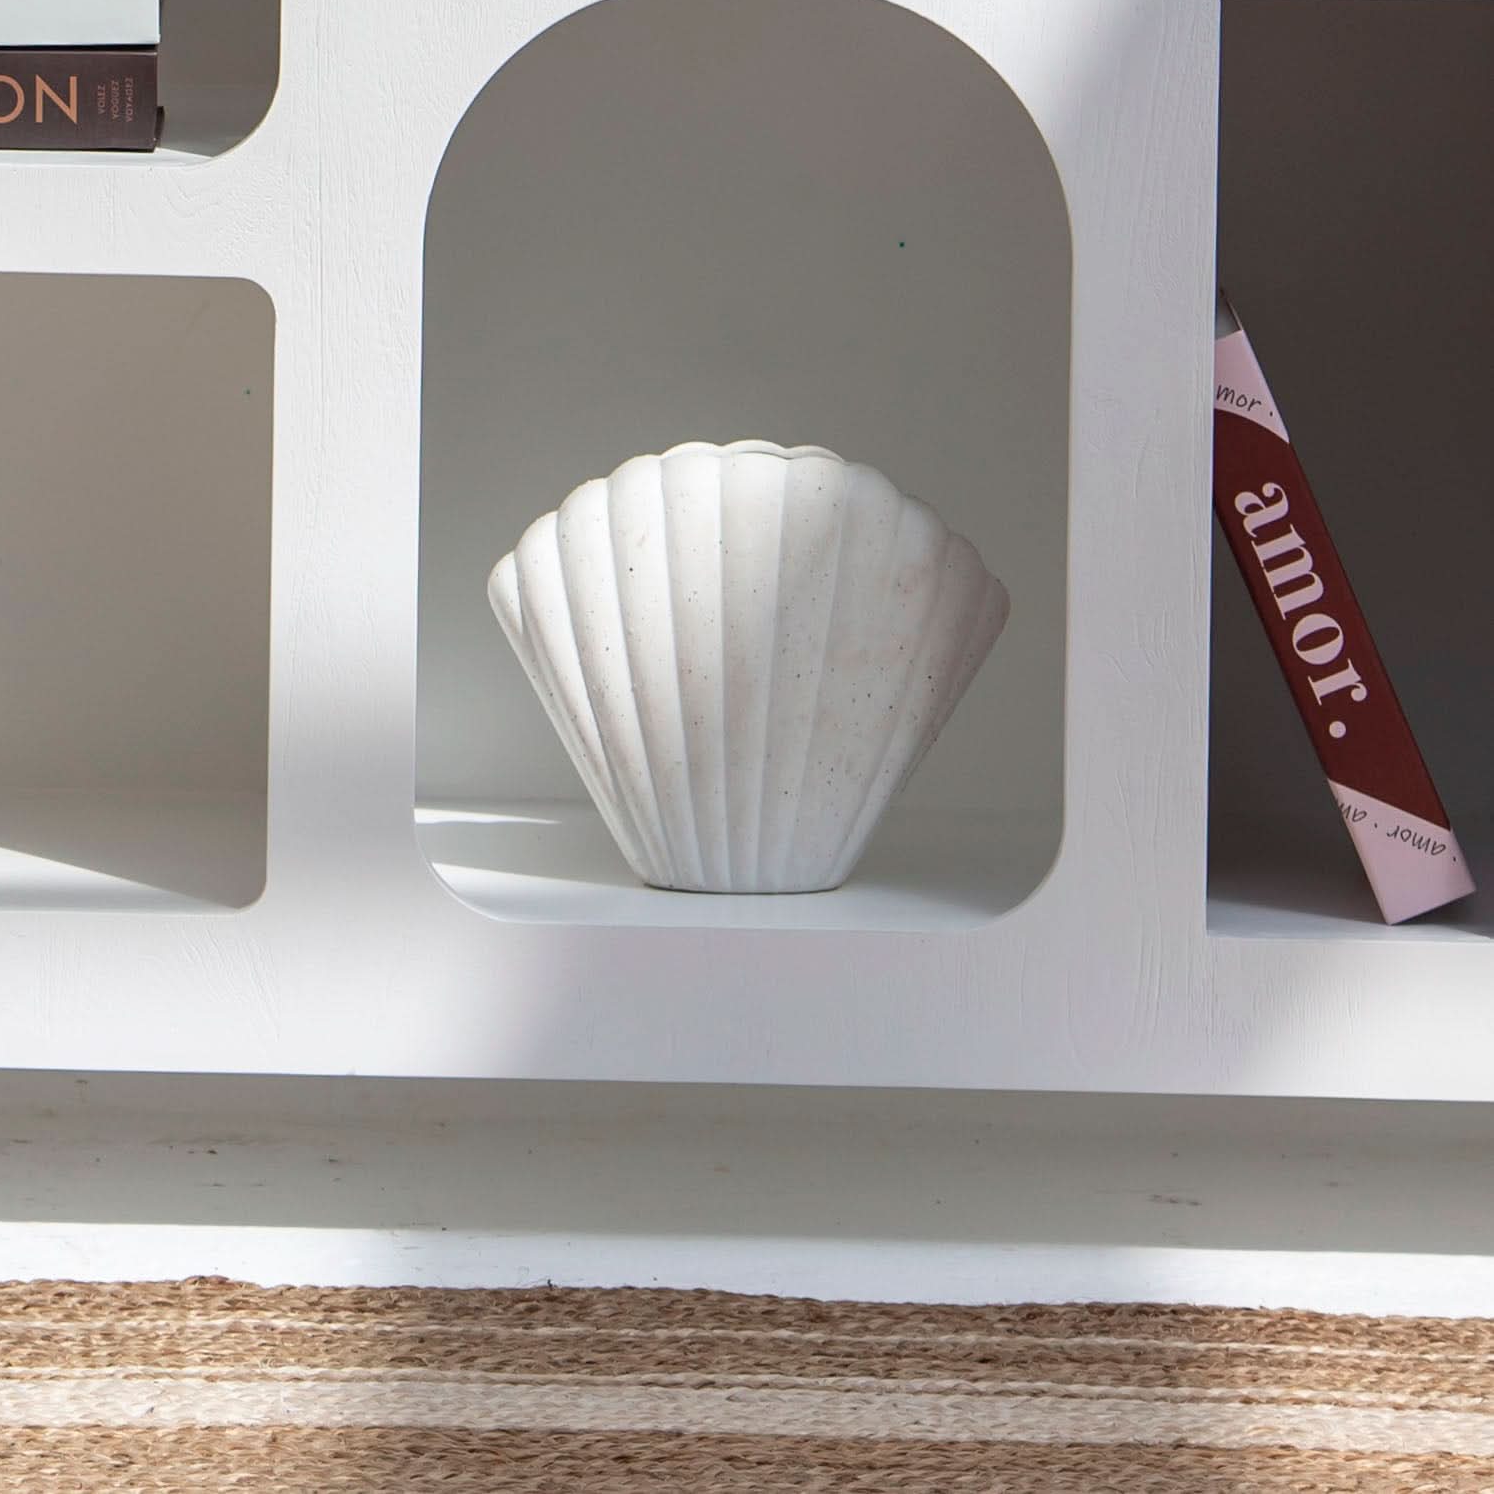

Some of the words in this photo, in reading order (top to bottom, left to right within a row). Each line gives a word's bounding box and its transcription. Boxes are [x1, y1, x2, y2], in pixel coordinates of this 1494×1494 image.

[1215, 384, 1262, 412] mor
[1234, 482, 1368, 739] amor.
[1386, 825, 1447, 856] amor
